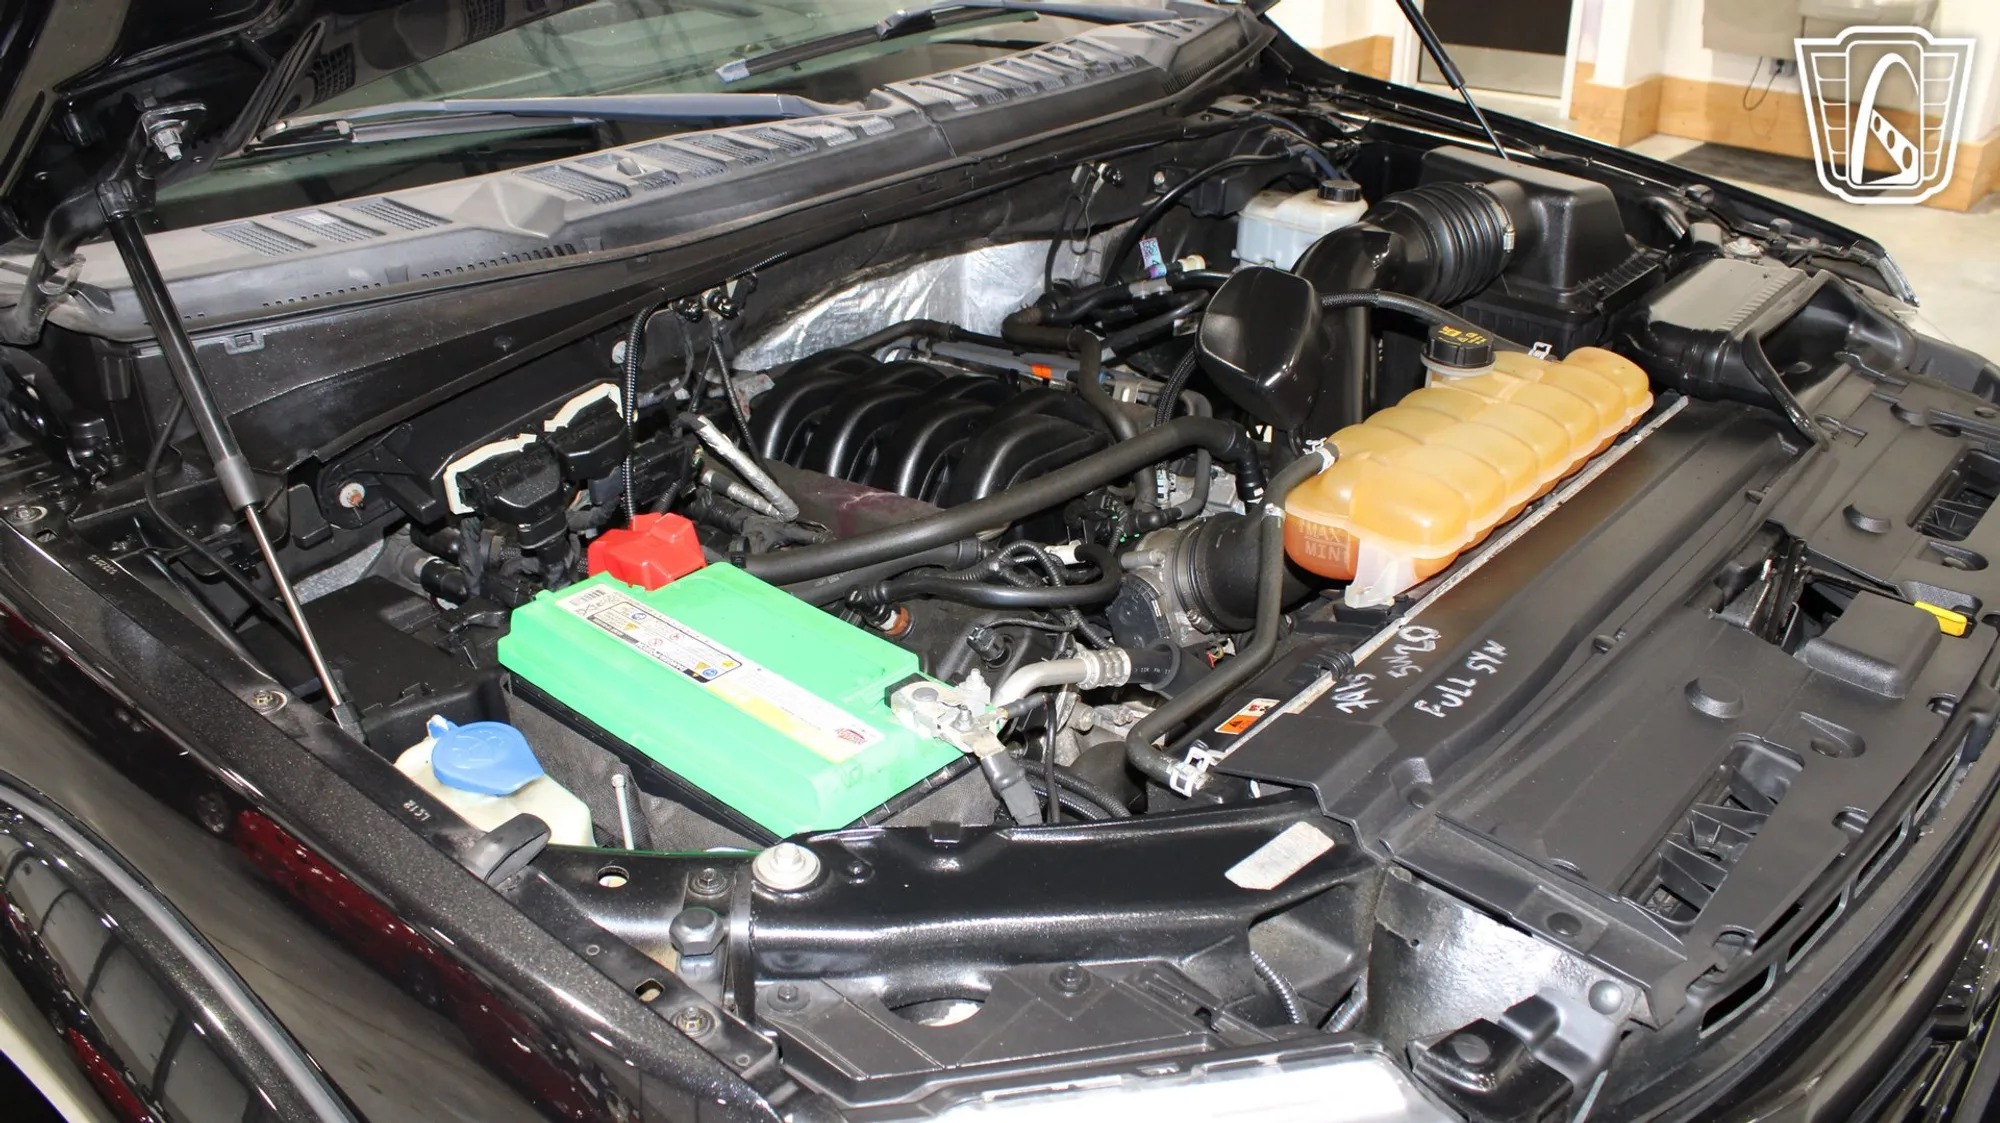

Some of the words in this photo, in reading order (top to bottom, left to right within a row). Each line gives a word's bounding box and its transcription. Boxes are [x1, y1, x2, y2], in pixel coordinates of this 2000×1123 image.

[1305, 521, 1341, 543] MAX
[1304, 540, 1341, 562] MIN
[1413, 677, 1477, 718] FULL
[1465, 639, 1508, 675] SYN
